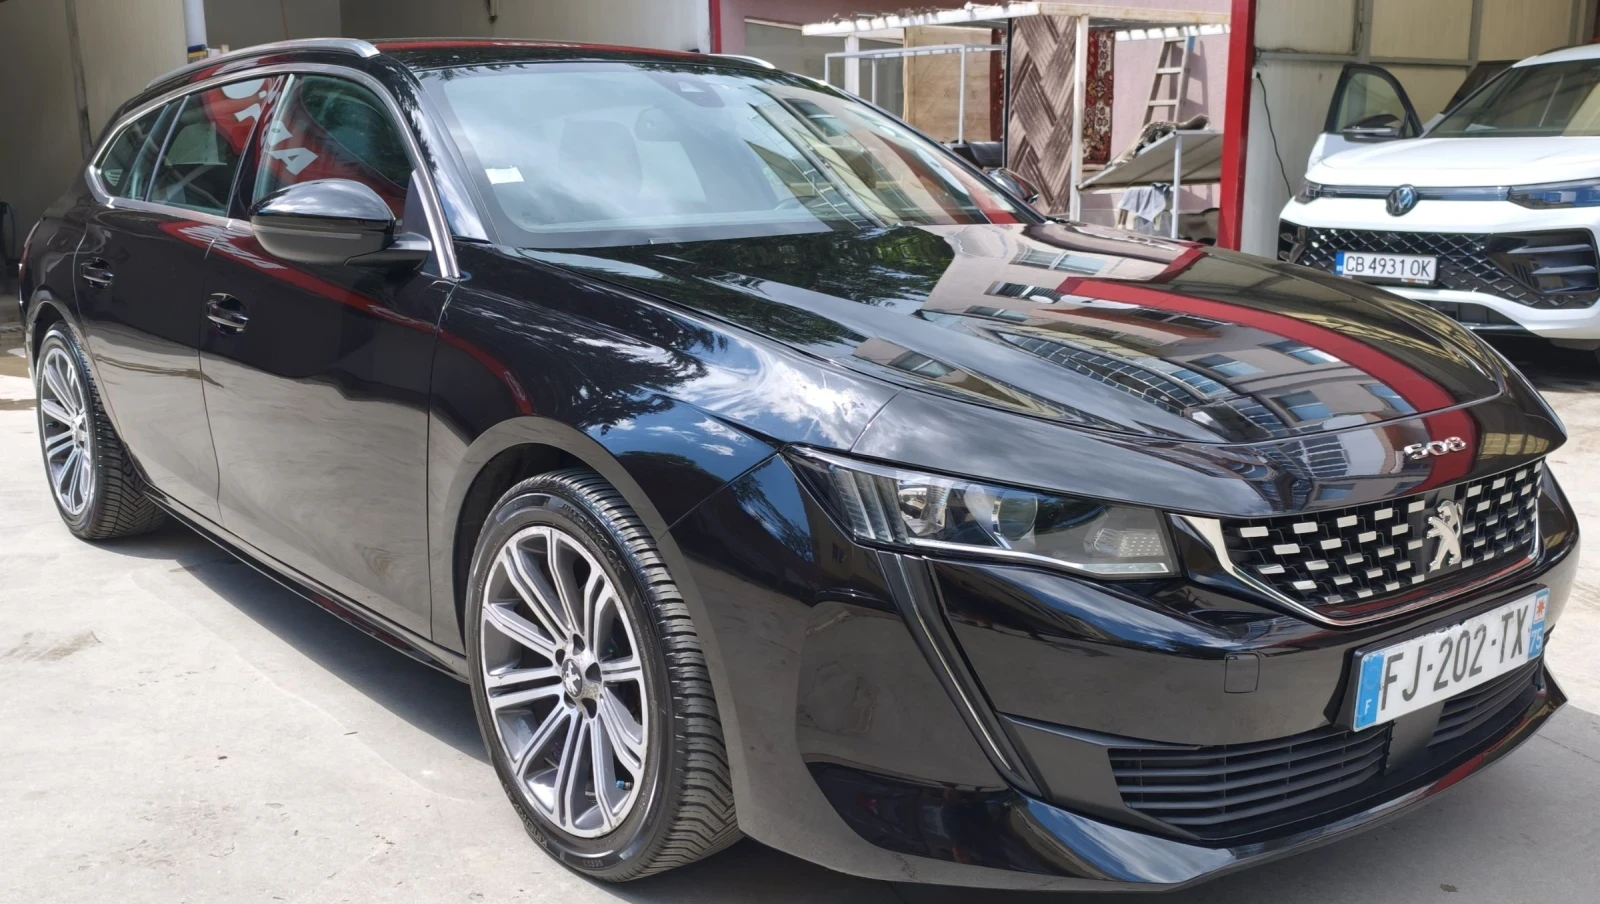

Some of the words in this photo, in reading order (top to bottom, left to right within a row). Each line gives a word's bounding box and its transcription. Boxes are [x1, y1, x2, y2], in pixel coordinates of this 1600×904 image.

[1346, 256, 1364, 273] CB
[1368, 257, 1405, 275] 4931
[1410, 259, 1431, 277] OK
[1404, 436, 1466, 460] 508
[1530, 627, 1543, 650] 75
[1365, 698, 1372, 715] F
